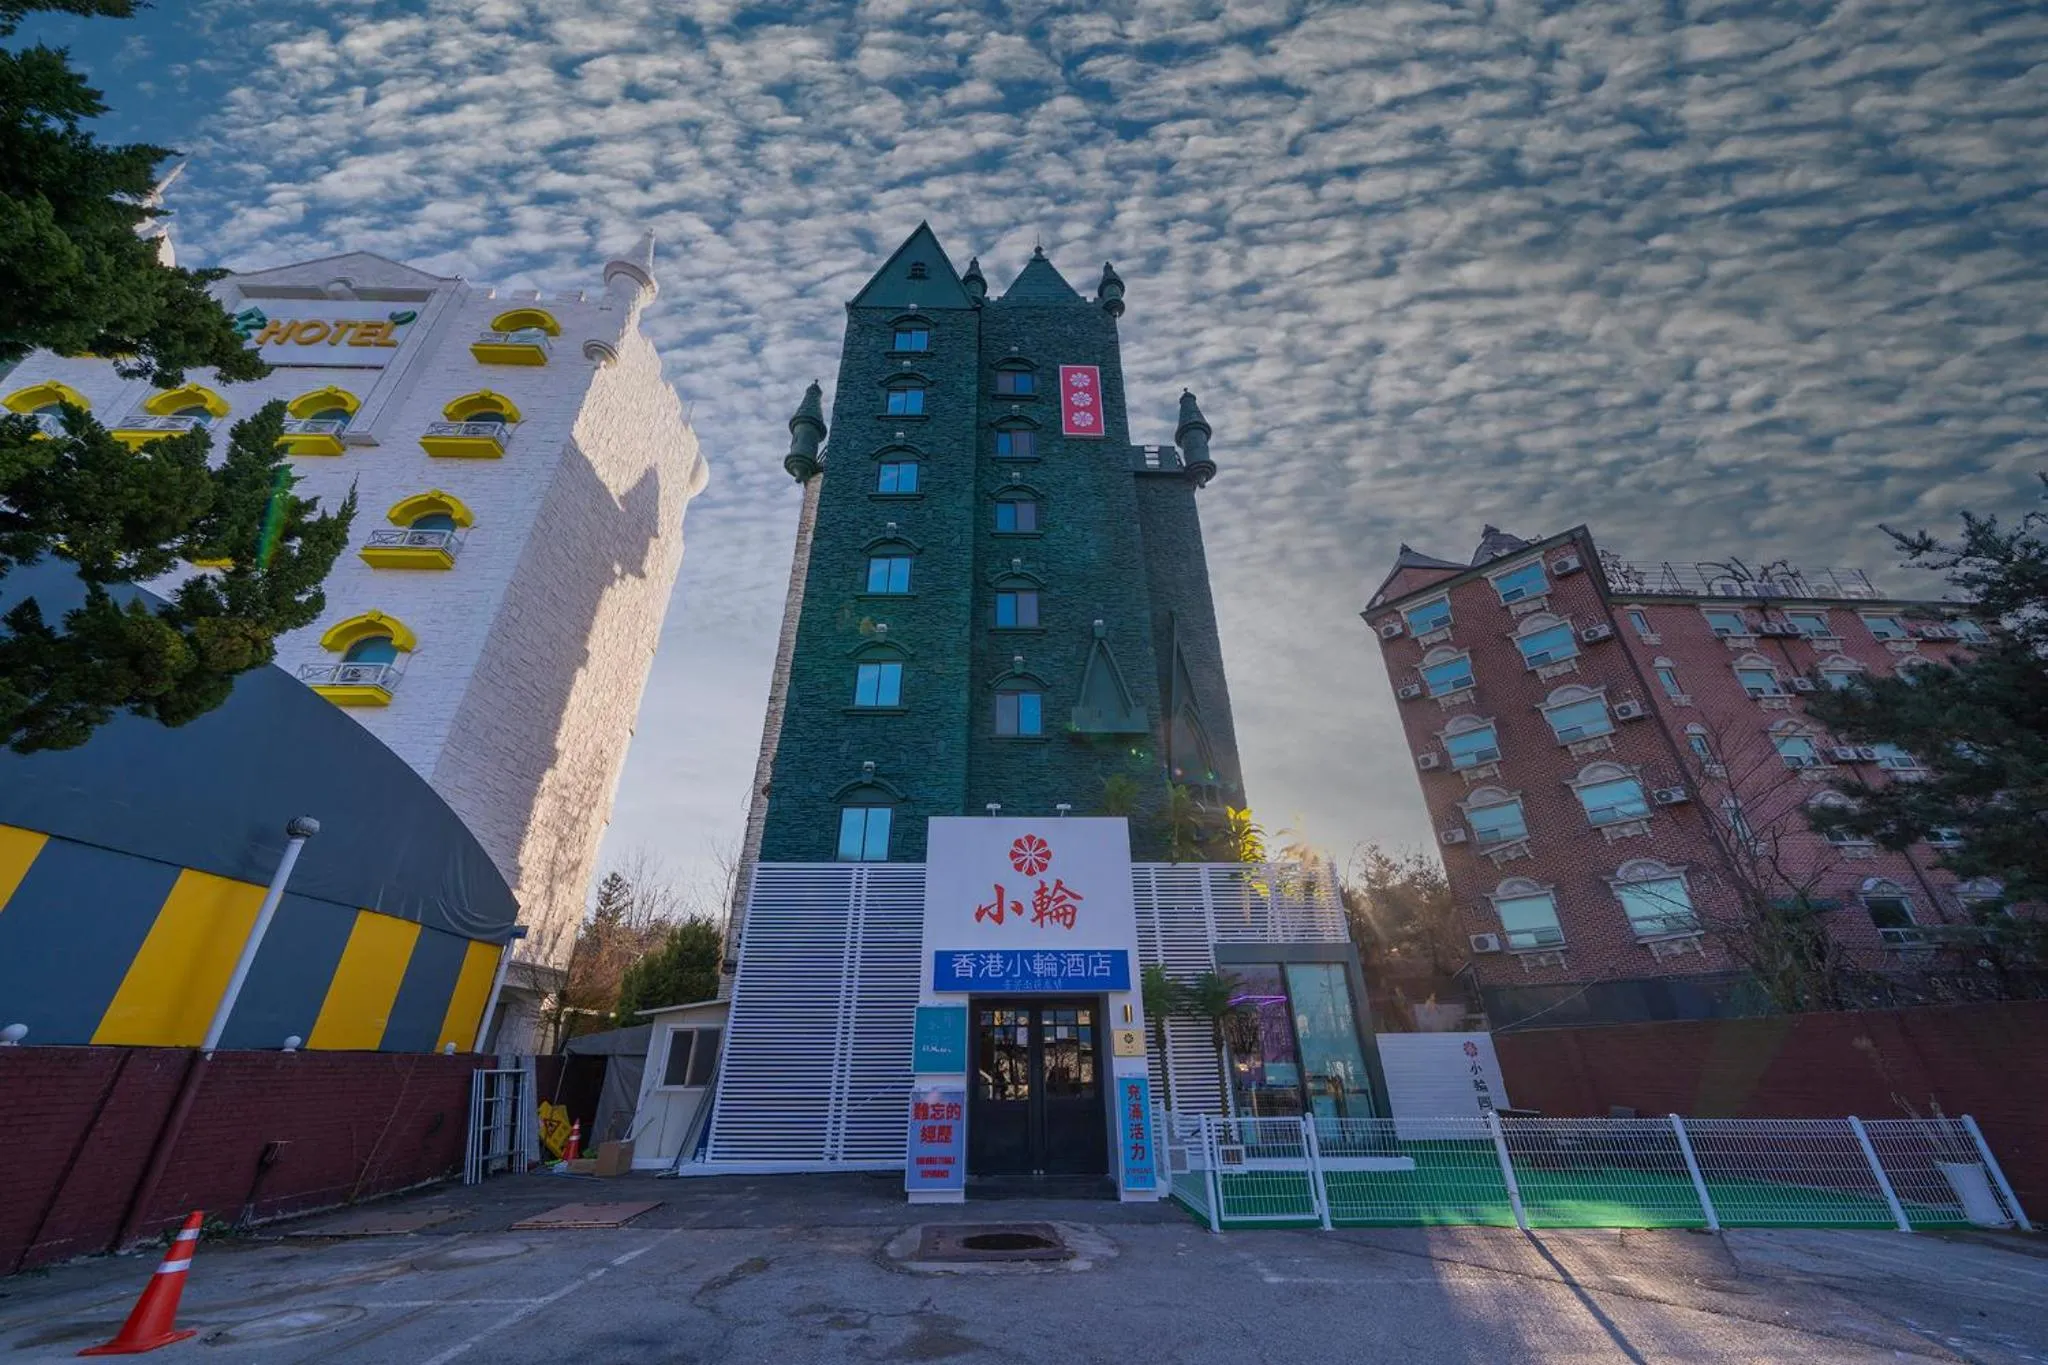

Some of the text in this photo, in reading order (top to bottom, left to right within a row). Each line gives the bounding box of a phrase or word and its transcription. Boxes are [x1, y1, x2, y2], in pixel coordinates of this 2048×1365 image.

[256, 319, 399, 347] HOTEL
[974, 879, 1084, 930] 小輪
[952, 952, 1112, 978] 香港小輪酒店
[913, 1102, 961, 1121] 難忘的
